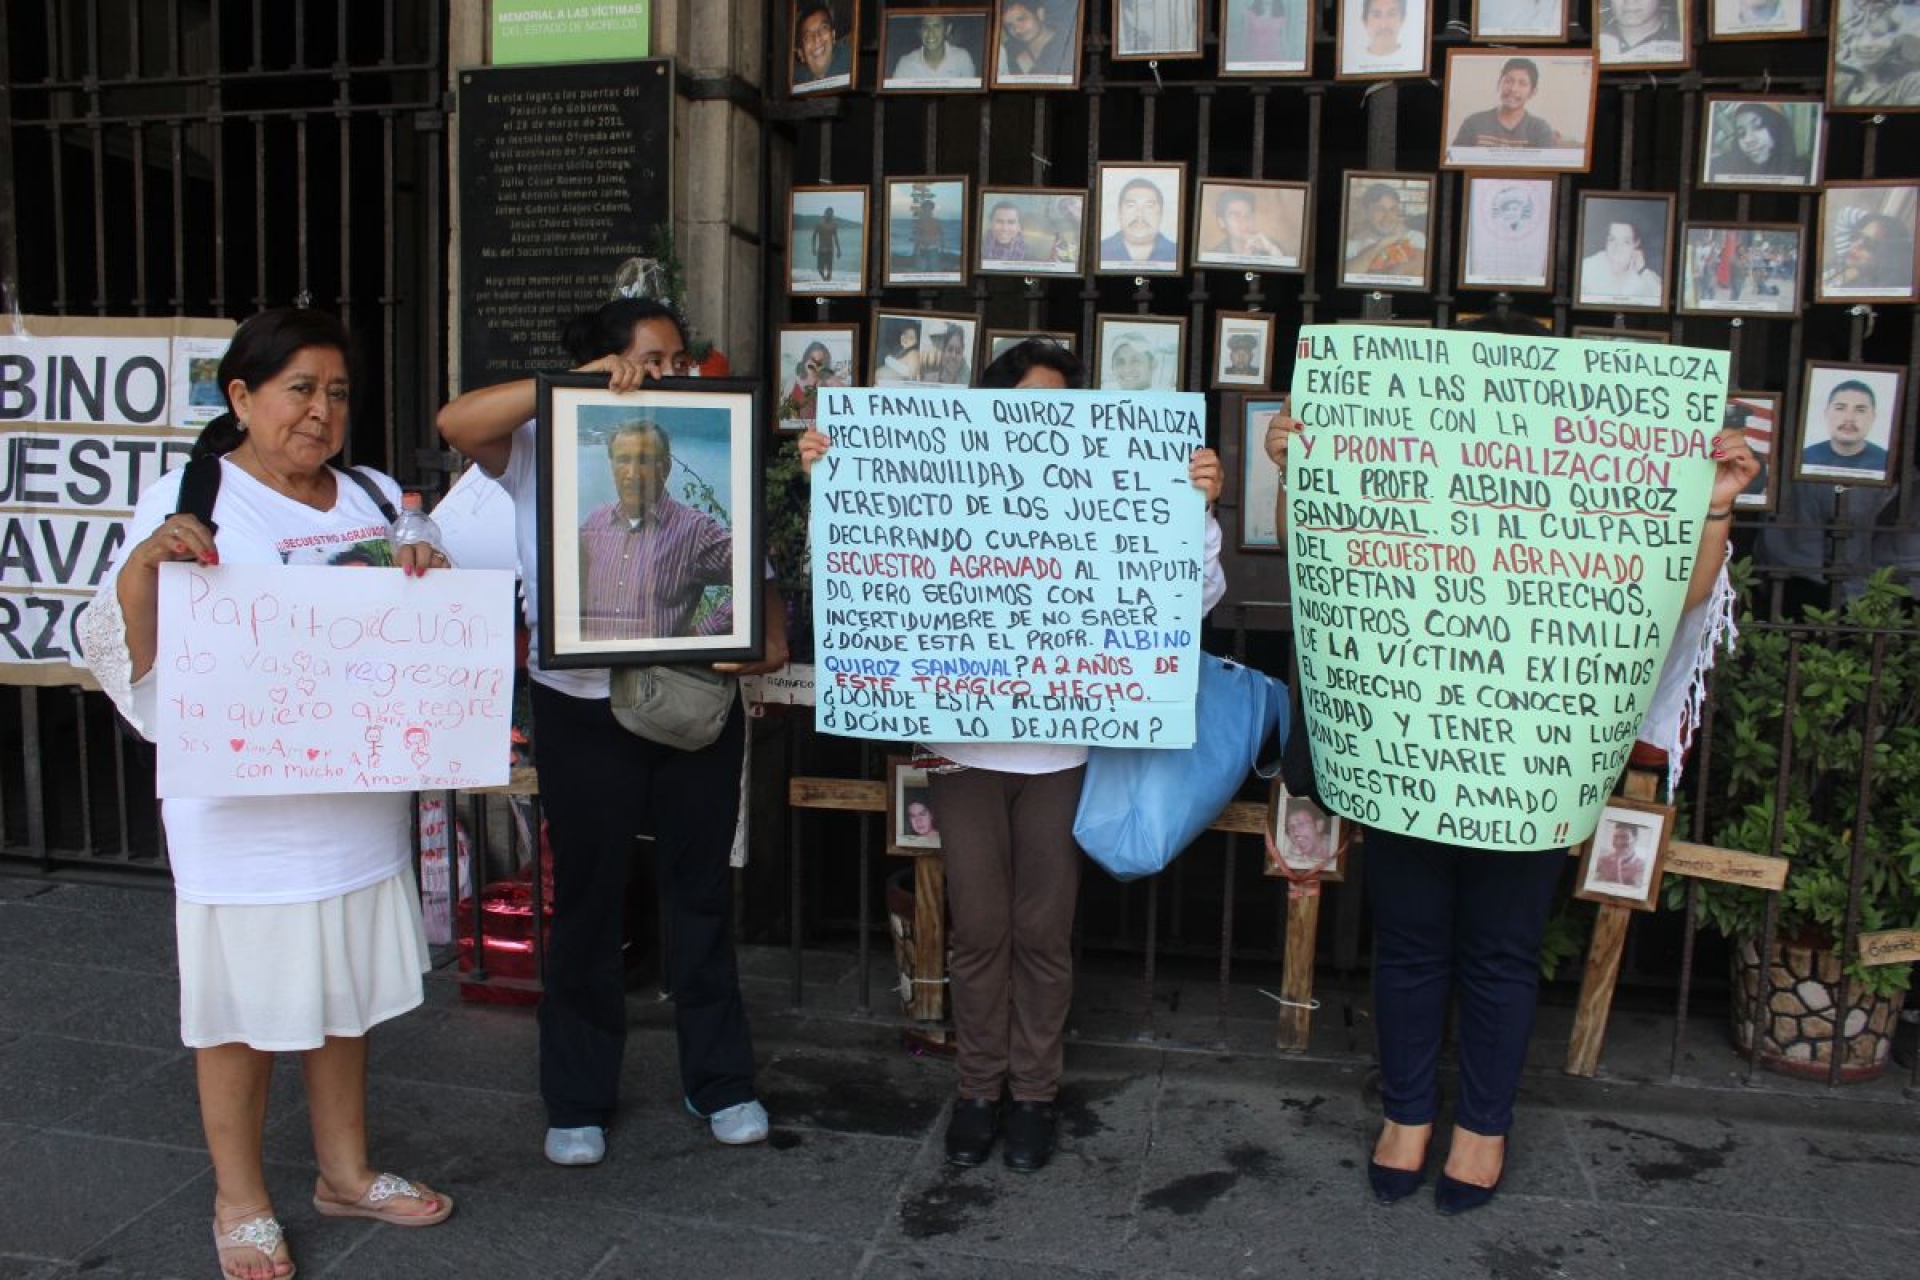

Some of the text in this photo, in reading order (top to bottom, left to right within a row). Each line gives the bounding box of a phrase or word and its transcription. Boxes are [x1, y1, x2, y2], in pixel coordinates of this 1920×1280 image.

[567, 6, 589, 18] LAS
[1354, 335, 1449, 364] FAMILIA
[1472, 342, 1559, 371] QUIROZ
[1584, 349, 1722, 384] PEÑALOZA
[829, 394, 1202, 439] LA FAMILIA QUIROZ PEÑALOZA
[1389, 373, 1405, 398] A
[1419, 374, 1464, 402] LAS
[1484, 378, 1669, 419] AUTORIDADES
[1686, 392, 1718, 423] SE
[828, 425, 1203, 464] RECIBIMOS UN POCO DE ALIVI
[1301, 402, 1707, 461] CONTINUE CON LA BÚSQUEDA
[827, 456, 1150, 492] Y TRANQUILIDAD CON EL
[1299, 435, 1671, 484] Y PRONTA LOCALIZACIÓN
[824, 490, 1170, 525] VEREDICTO DE LOS JUECES
[1299, 467, 1677, 512] DEL PROFR. ALBINO QUIROZ
[829, 523, 1158, 554] DECLARANDO CULPABLE DEL
[1451, 510, 1479, 536] SI
[1499, 514, 1527, 539] AL
[1541, 513, 1693, 547] CULPABLE
[827, 552, 936, 579] SECUESTRO
[950, 555, 1061, 579] AGRAVADO
[1075, 560, 1099, 580] AL
[1296, 531, 1692, 584] DEL SECUESTRO AGRAVADO LE
[862, 582, 910, 605] PERO
[922, 581, 1032, 605] SEGUIMOS
[1048, 585, 1094, 605] CON
[1118, 587, 1153, 605] LA
[1296, 563, 1651, 618] RESPETAN SUS DERECHOS,
[190, 570, 363, 650] Papito
[827, 608, 1157, 632] INCERTIDUMBRE DE NO SABER
[1299, 597, 1659, 649] NOSOTROS COMO FAMILIA
[918, 633, 975, 651] ESTA
[988, 633, 1015, 650] EL
[1027, 629, 1093, 650] PROFR.
[1104, 629, 1191, 650] ALBINO
[1301, 625, 1317, 652] DE
[1329, 632, 1359, 661] LA
[1378, 638, 1504, 675] VÍCTIMA
[826, 659, 900, 677] QUIROZ
[1032, 656, 1046, 674] A
[1055, 656, 1071, 674] 2
[1077, 653, 1133, 675] AÑOS
[1154, 656, 1178, 674] DE
[835, 674, 891, 692] ESTE
[1050, 683, 1150, 702] HECHO.
[1326, 665, 1421, 702] DERECHO
[1435, 685, 1466, 706] DE
[1477, 685, 1599, 717] CONOCER
[1615, 693, 1635, 714] LA
[229, 701, 332, 729] quiero
[352, 700, 407, 723] que
[824, 706, 932, 736] ¿DÓNDE
[955, 717, 989, 738] LO
[1393, 712, 1410, 738] Y
[1428, 714, 1516, 744] TENER
[1536, 725, 1571, 744] UN
[1591, 712, 1643, 743] LUGAR
[284, 763, 344, 779] mucho
[1523, 755, 1572, 777] UNA
[1325, 758, 1436, 805] NUESTRO
[1456, 784, 1557, 814] AMADO
[1401, 807, 1419, 831] Y
[1437, 813, 1536, 845] ABUELO
